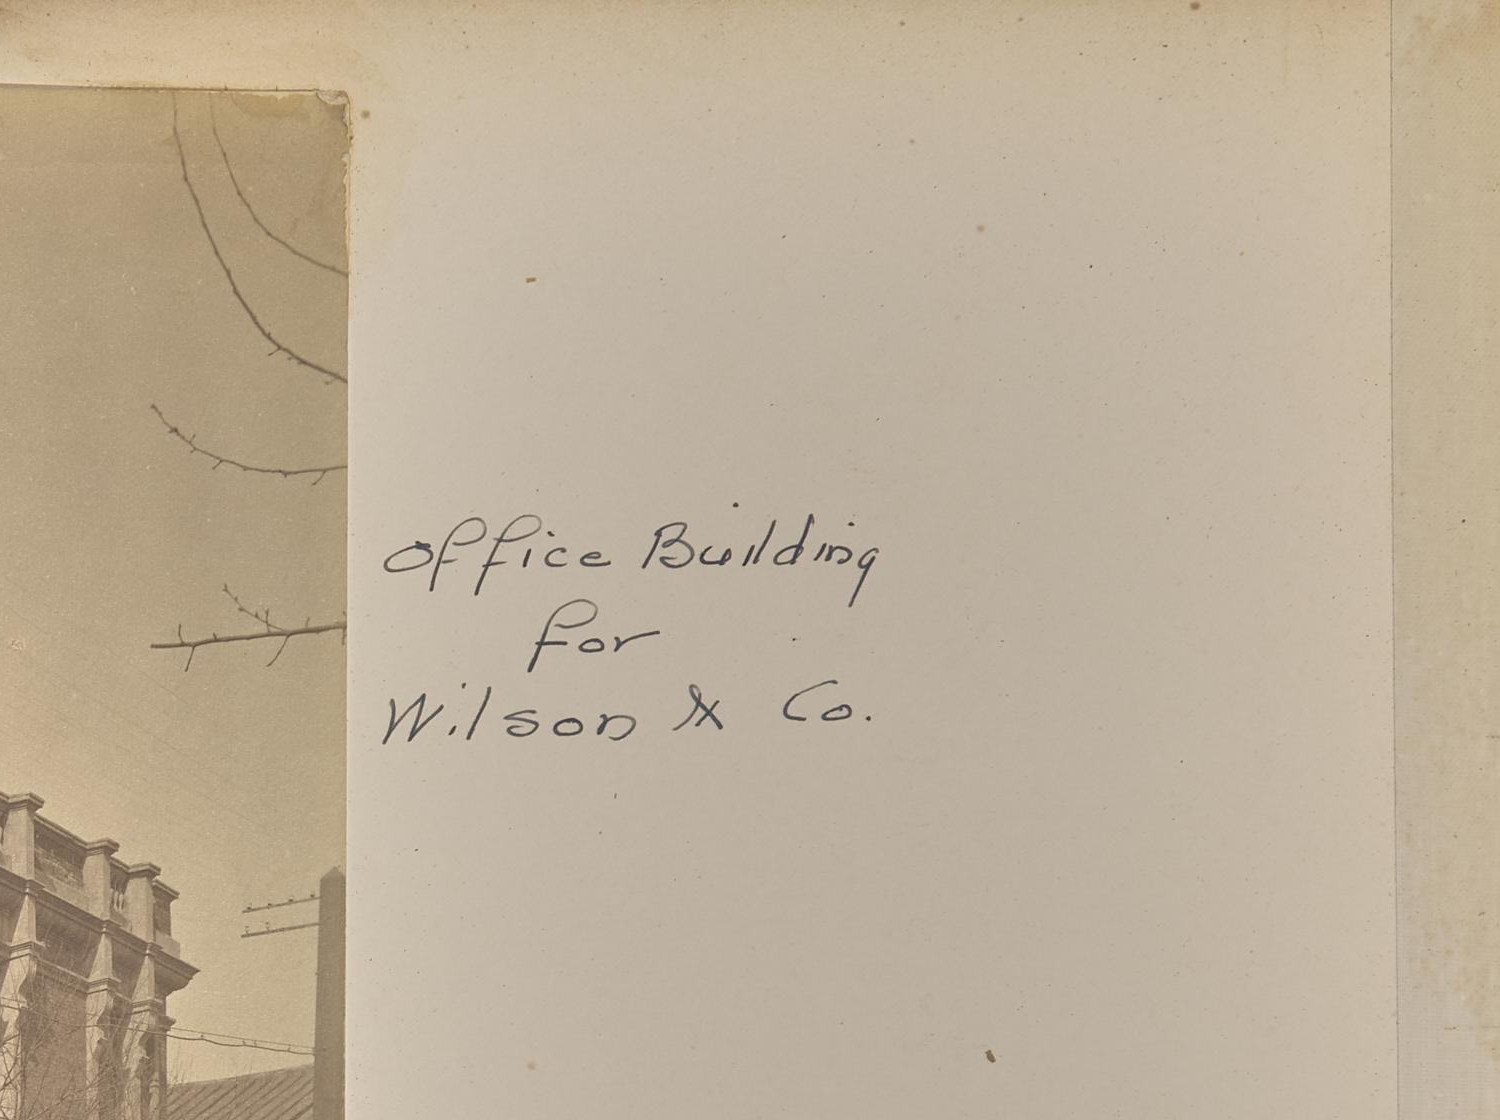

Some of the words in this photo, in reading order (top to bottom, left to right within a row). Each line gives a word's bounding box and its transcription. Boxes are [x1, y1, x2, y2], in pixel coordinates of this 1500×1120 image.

[641, 510, 880, 609] Building
[527, 598, 661, 674] for
[382, 682, 637, 746] Wilson
[671, 684, 724, 732] &
[782, 679, 872, 722] Co.
